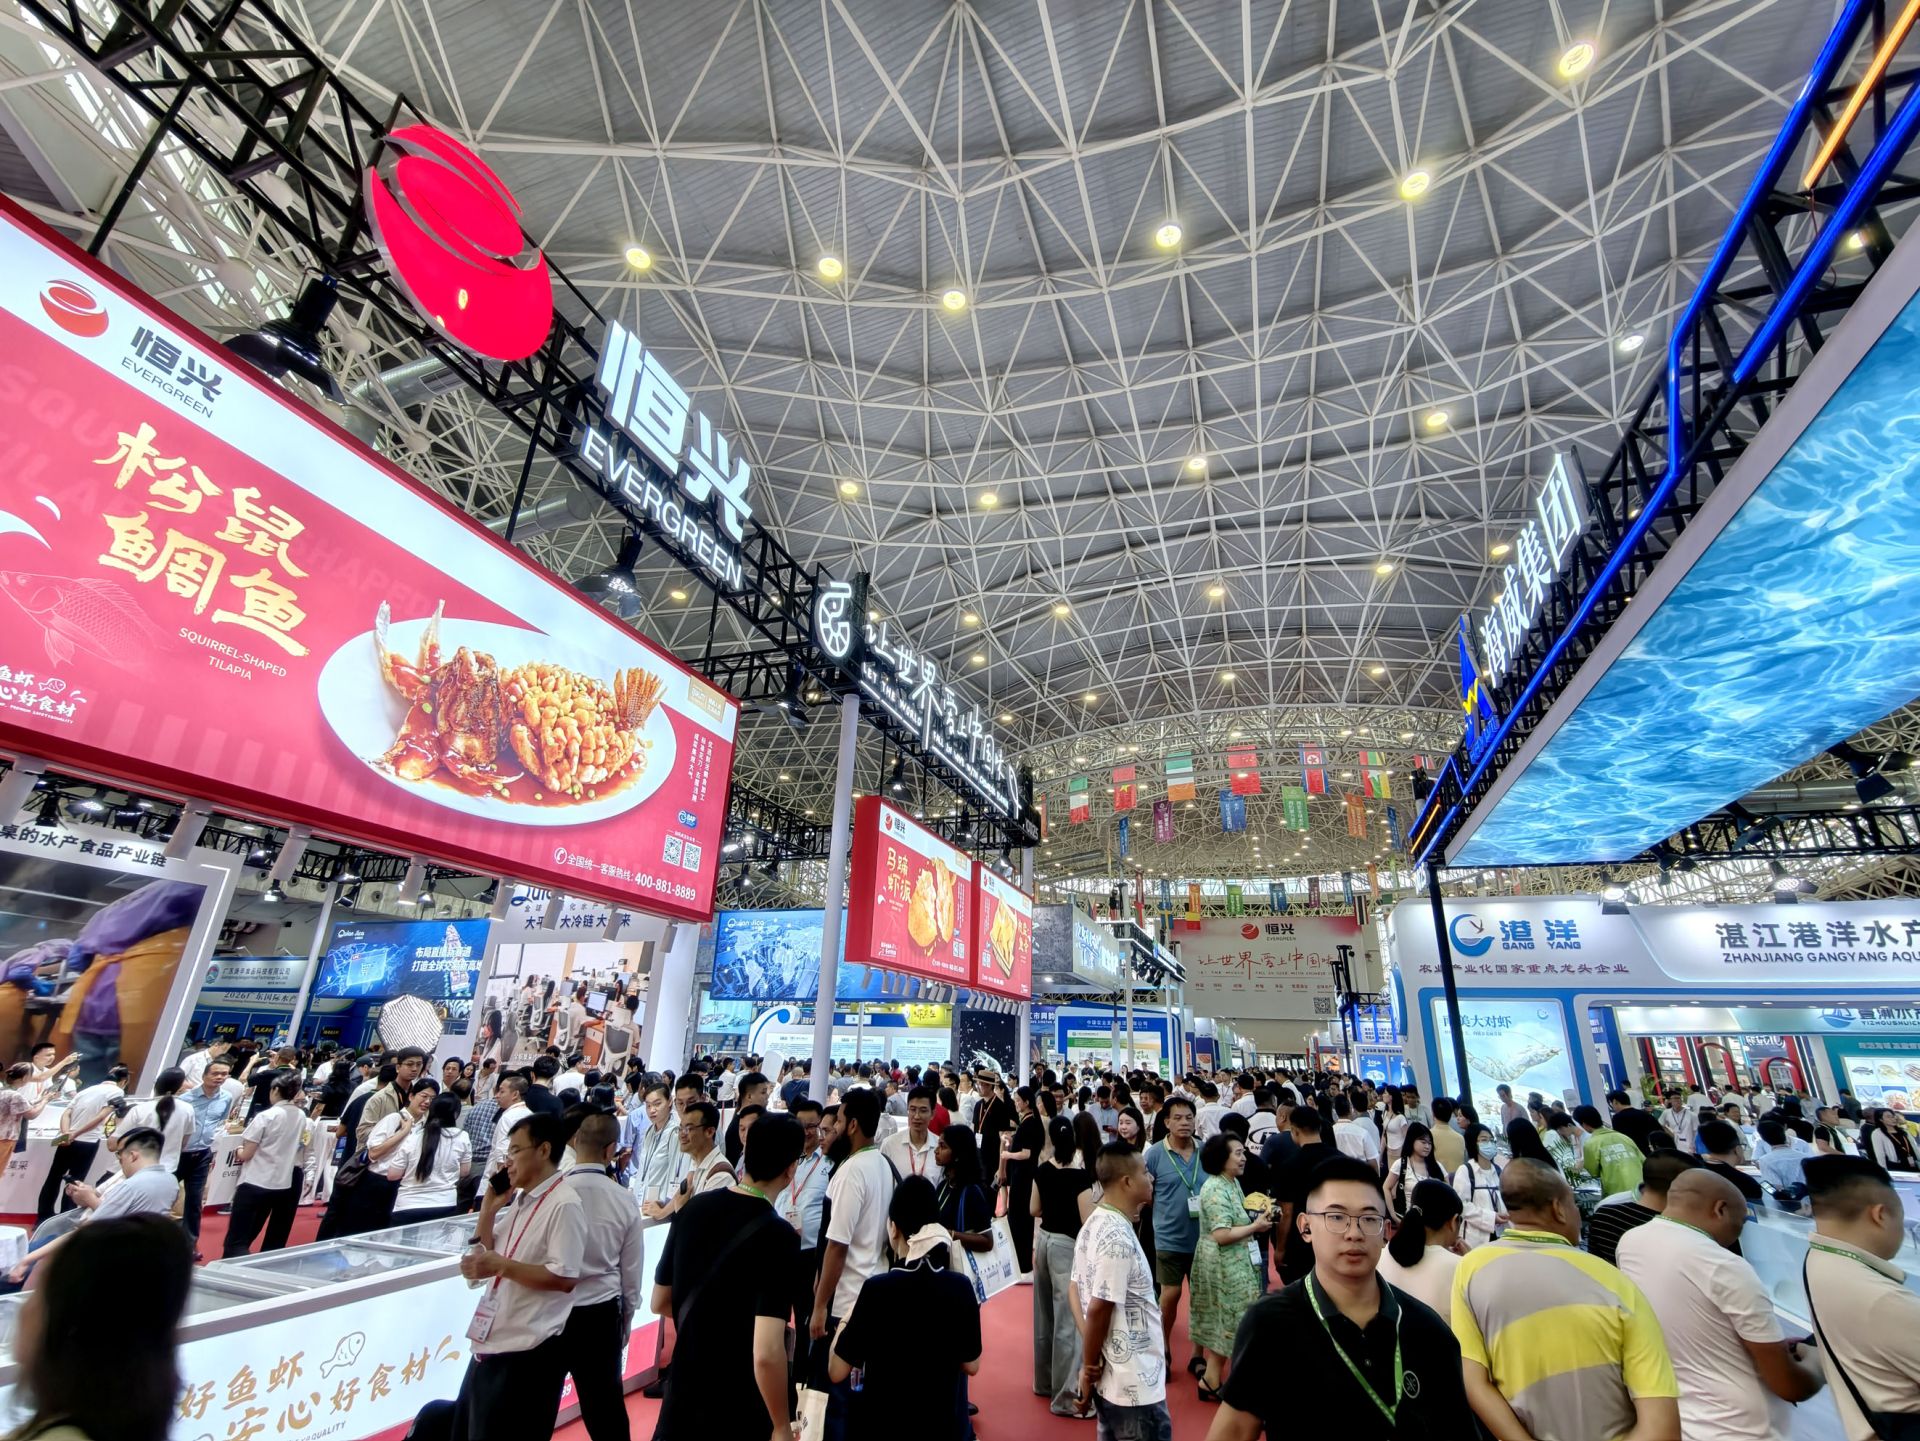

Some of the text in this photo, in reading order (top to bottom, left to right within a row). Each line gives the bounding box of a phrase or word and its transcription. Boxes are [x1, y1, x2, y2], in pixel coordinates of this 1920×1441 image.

[121, 356, 213, 419] EVERGREEN
[131, 325, 224, 402] 恒兴
[600, 320, 753, 543] 恒兴
[94, 422, 309, 578] 松鼠
[583, 426, 742, 589] EVERGREEN
[98, 511, 311, 657] 鲷鱼
[1481, 453, 1581, 688] 海威集团
[179, 627, 288, 679] SQUIRREL-SHAPED
[208, 655, 253, 681] TILAPIA
[881, 681, 896, 702] THE
[899, 698, 922, 727] WORLD
[0, 823, 167, 868] 桌的水产食品产业链
[635, 872, 696, 900] 400-881-8889
[559, 914, 594, 929] 大冷链
[596, 913, 632, 928] 大来
[1265, 923, 1295, 935] 恒兴
[1498, 919, 1579, 942] 港洋
[1502, 941, 1581, 950] GANG YANG
[1715, 920, 1920, 949] 湛江港洋水产
[1723, 952, 1804, 964] ZHANJIANG
[1807, 951, 1888, 962] GANGYANG
[177, 1351, 305, 1421] 好鱼虾
[222, 1347, 432, 1441] 安心好食材
